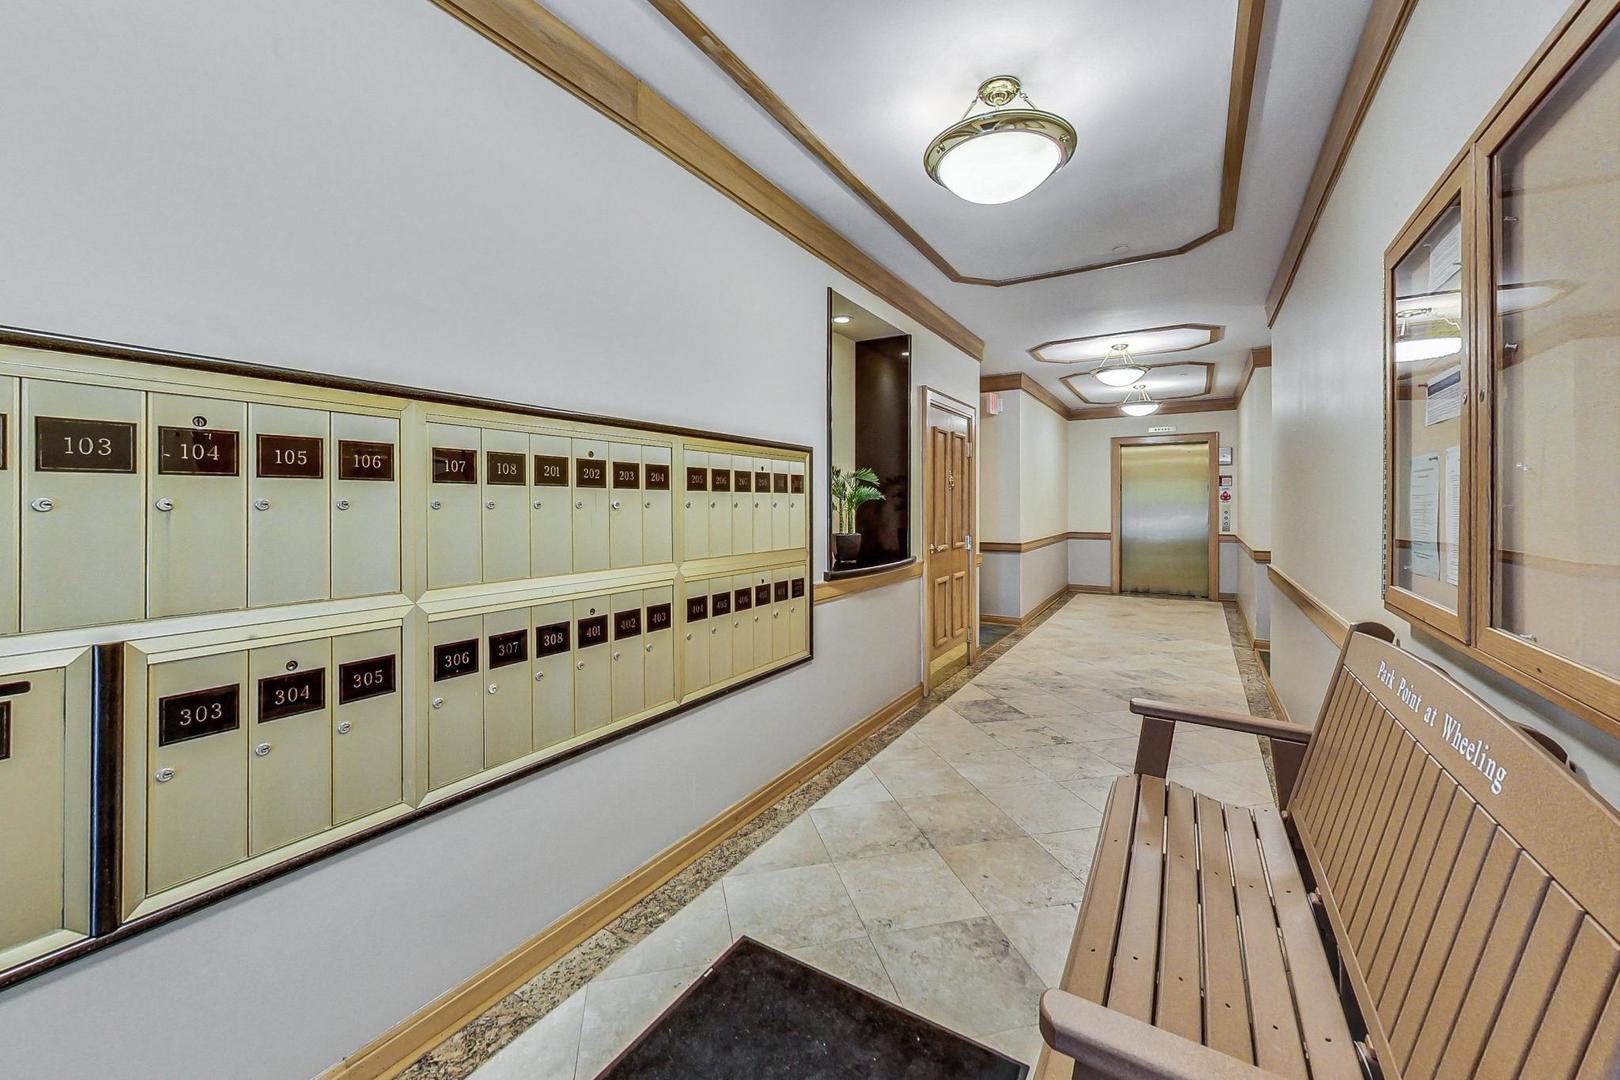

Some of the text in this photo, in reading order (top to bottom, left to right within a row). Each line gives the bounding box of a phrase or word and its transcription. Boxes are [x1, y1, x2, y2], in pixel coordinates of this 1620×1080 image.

[64, 436, 112, 456] 103
[180, 443, 220, 461] 104
[274, 449, 308, 465] 105
[353, 454, 382, 469] 106
[444, 460, 466, 473] 107
[497, 463, 517, 475] 108
[543, 465, 561, 478] 201
[583, 468, 600, 480] 202
[619, 470, 635, 481] 203
[650, 472, 665, 482] 204
[620, 618, 636, 630] 402
[652, 612, 667, 624] 403
[586, 625, 601, 638] 401
[543, 632, 564, 647] 308
[498, 641, 519, 657] 307
[444, 651, 470, 668] 306
[353, 669, 384, 689] 305
[274, 684, 310, 706] 304
[179, 702, 223, 727] 303
[1376, 660, 1508, 796] Park Point at Wheeling
